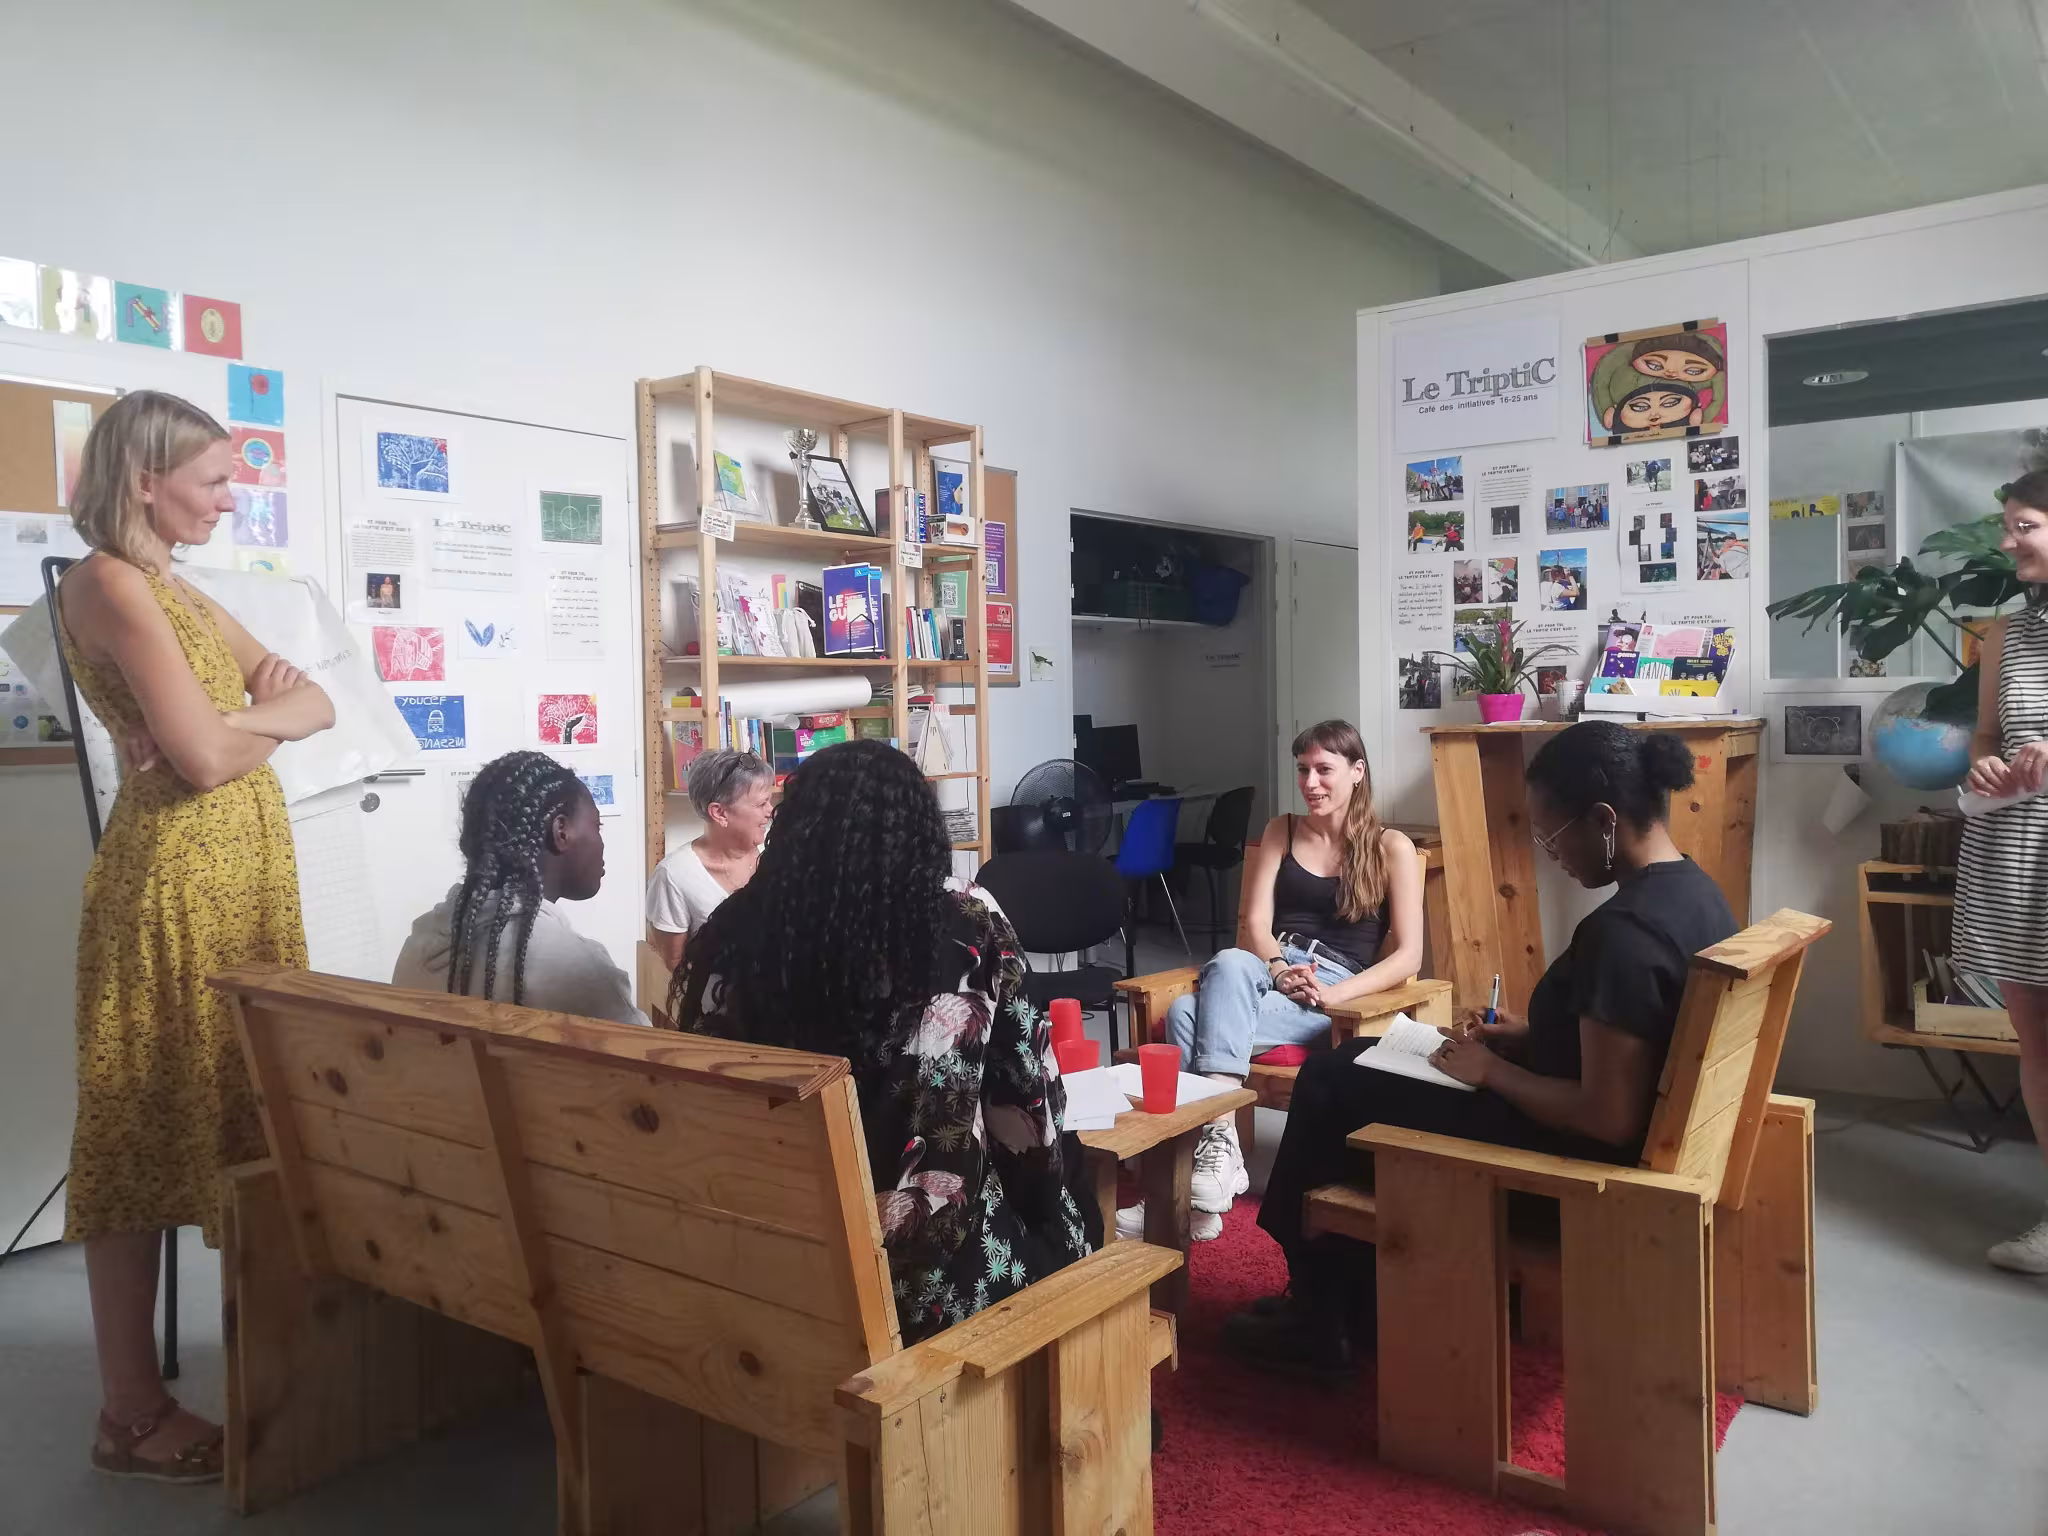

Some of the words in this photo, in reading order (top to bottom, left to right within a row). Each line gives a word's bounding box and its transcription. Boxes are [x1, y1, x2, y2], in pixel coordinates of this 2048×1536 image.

[1402, 377, 1440, 403] Le
[1446, 356, 1557, 397] TriptiC
[1418, 406, 1436, 414] Café
[1439, 404, 1454, 412] des
[1458, 399, 1495, 410] initiatives
[1500, 395, 1521, 404] 16-25
[1523, 394, 1538, 402] ans
[457, 521, 511, 533] TriptiC
[828, 594, 844, 609] LE
[401, 695, 447, 706] YOUCEF
